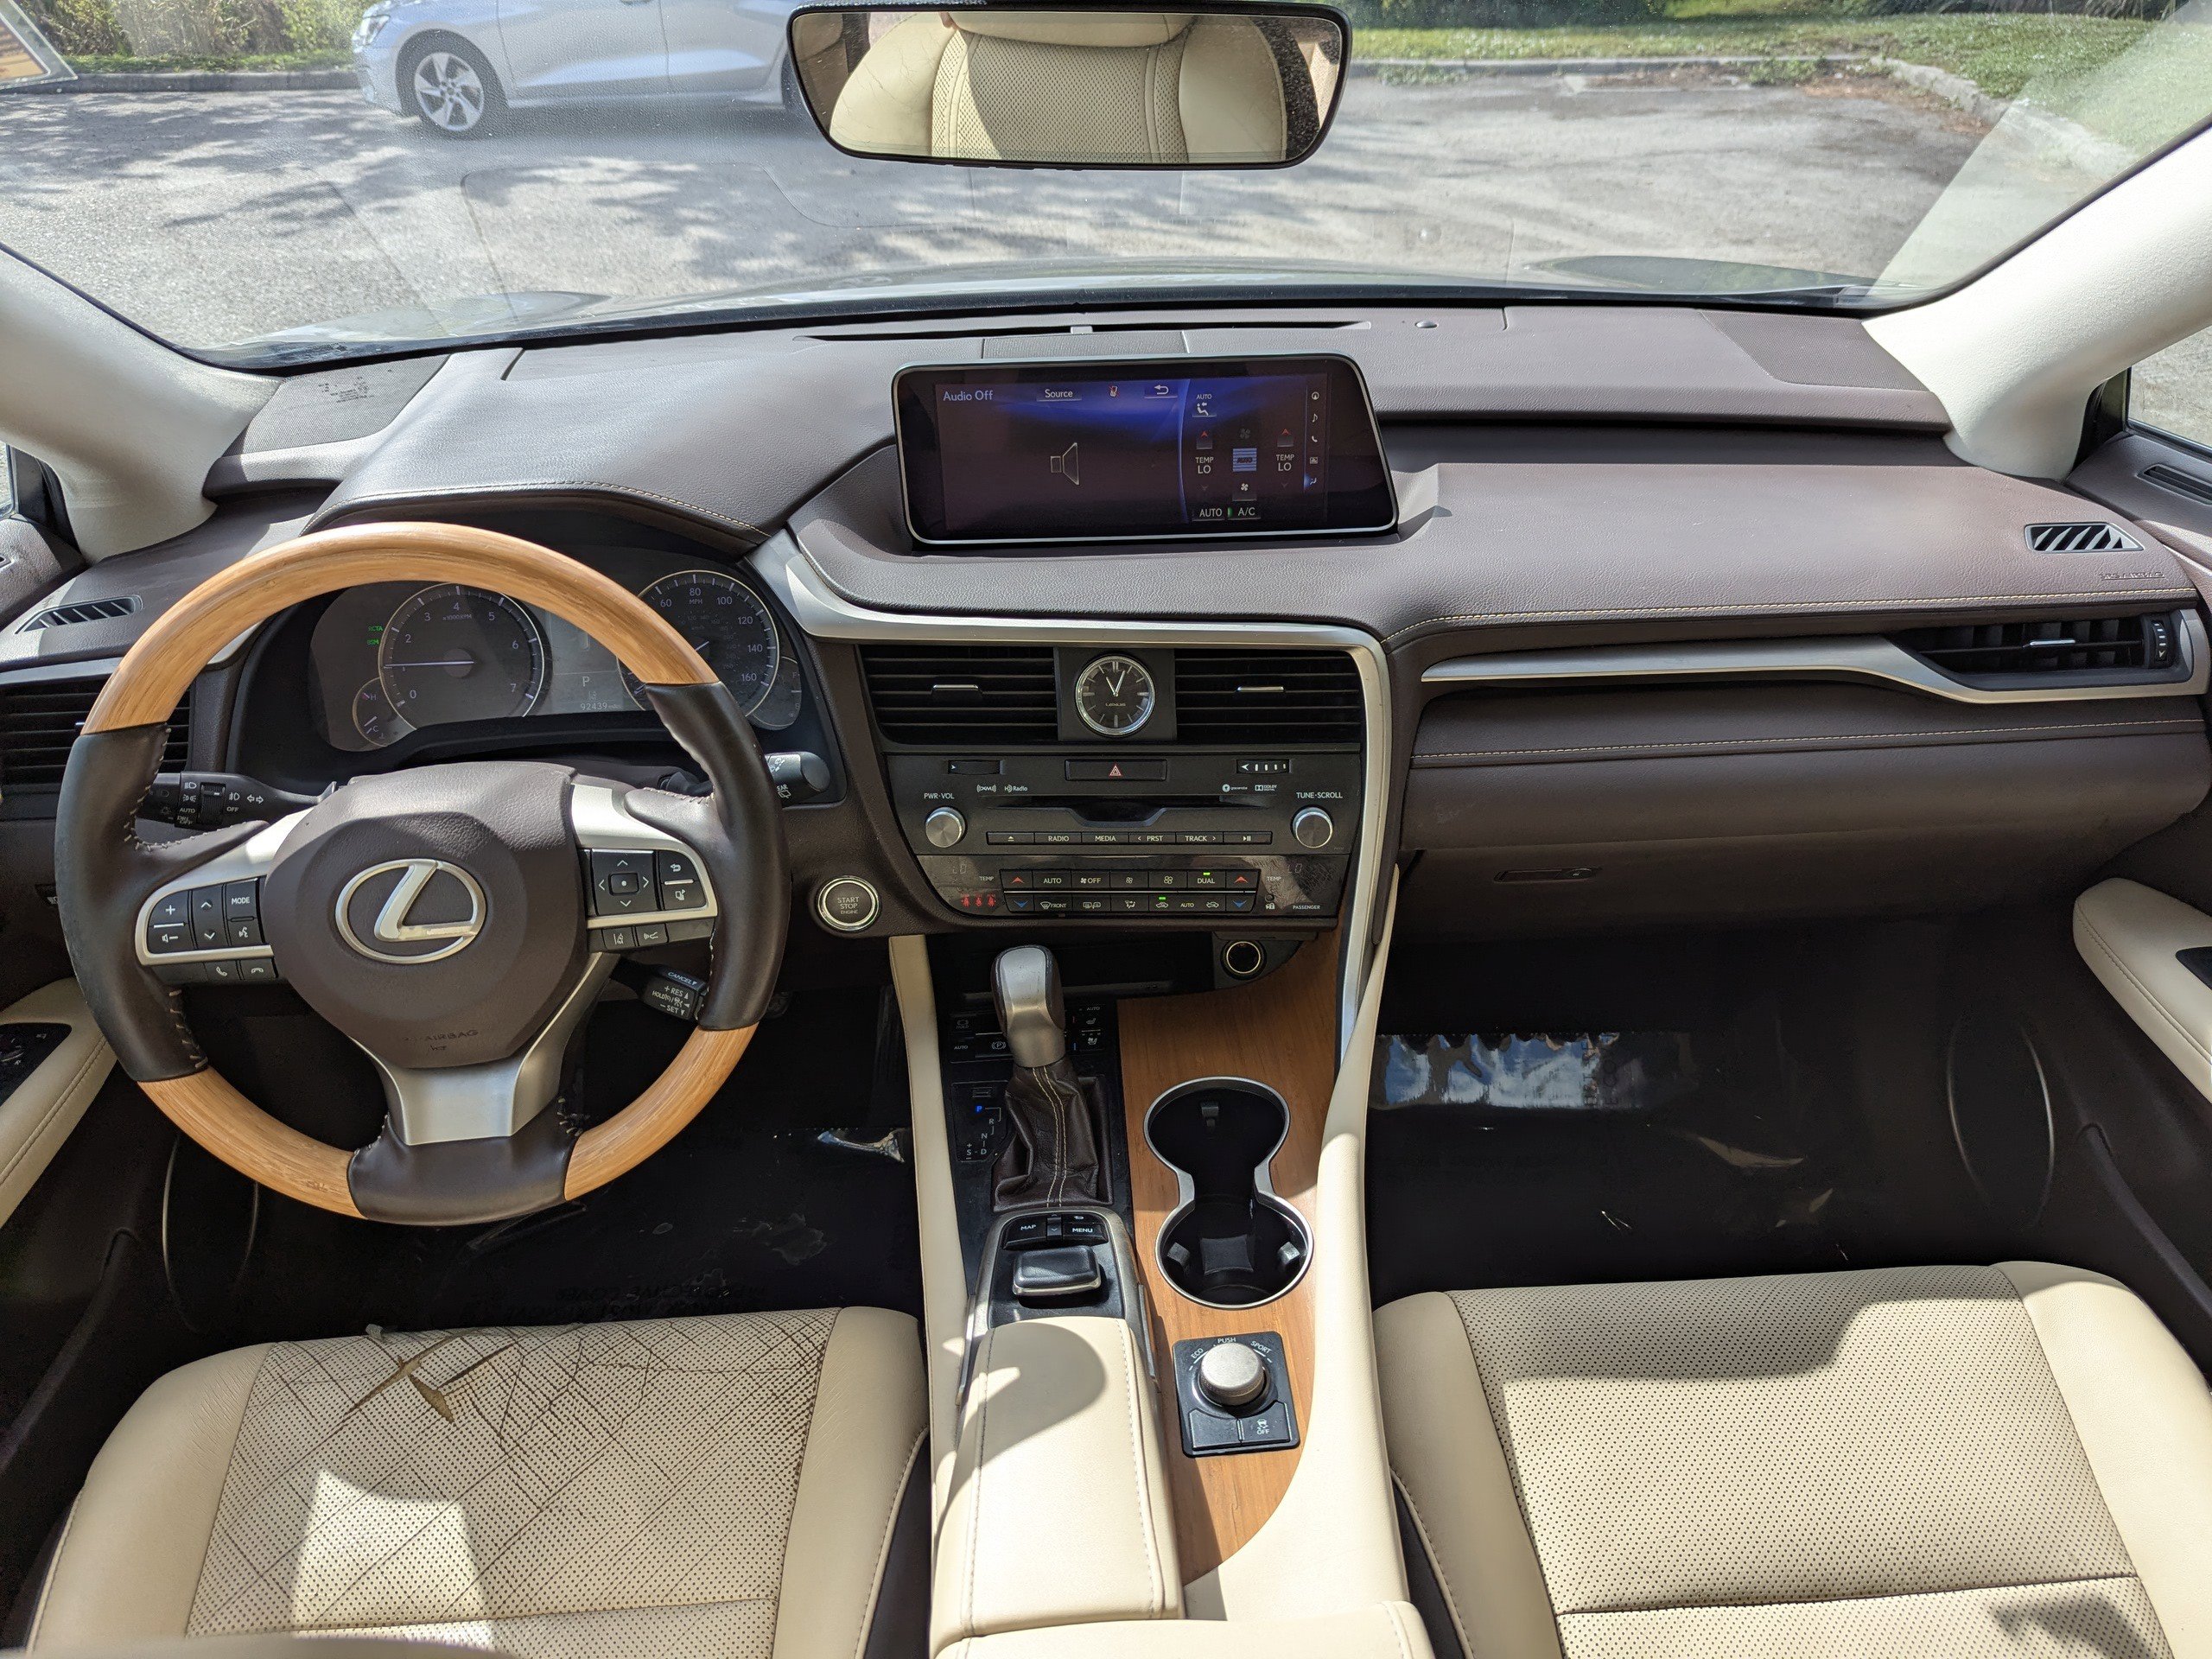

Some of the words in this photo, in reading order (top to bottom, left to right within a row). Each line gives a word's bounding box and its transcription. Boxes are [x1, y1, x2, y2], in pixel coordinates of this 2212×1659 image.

[943, 391, 973, 402] Audio
[975, 390, 994, 401] Off
[1045, 388, 1073, 398] Source
[1197, 465, 1211, 474] LO
[1277, 462, 1293, 472] LO
[1199, 507, 1223, 518] AUTO
[1237, 506, 1255, 517] A/C
[689, 588, 702, 596] 80
[453, 601, 460, 611] 4
[660, 598, 672, 607] 60
[716, 596, 733, 606] 100
[424, 612, 431, 621] 3
[488, 612, 495, 621] 5
[737, 616, 753, 625] 120
[404, 633, 412, 644] 2
[512, 639, 518, 650] 6
[747, 644, 763, 652] 140
[582, 676, 590, 687] P
[741, 672, 757, 682] 160
[510, 683, 517, 692] 7
[410, 690, 417, 699] 0
[580, 702, 607, 710] 92439
[667, 971, 692, 984] CANCEL
[1250, 1340, 1273, 1354] SPORT
[1191, 1348, 1204, 1360] ECO
